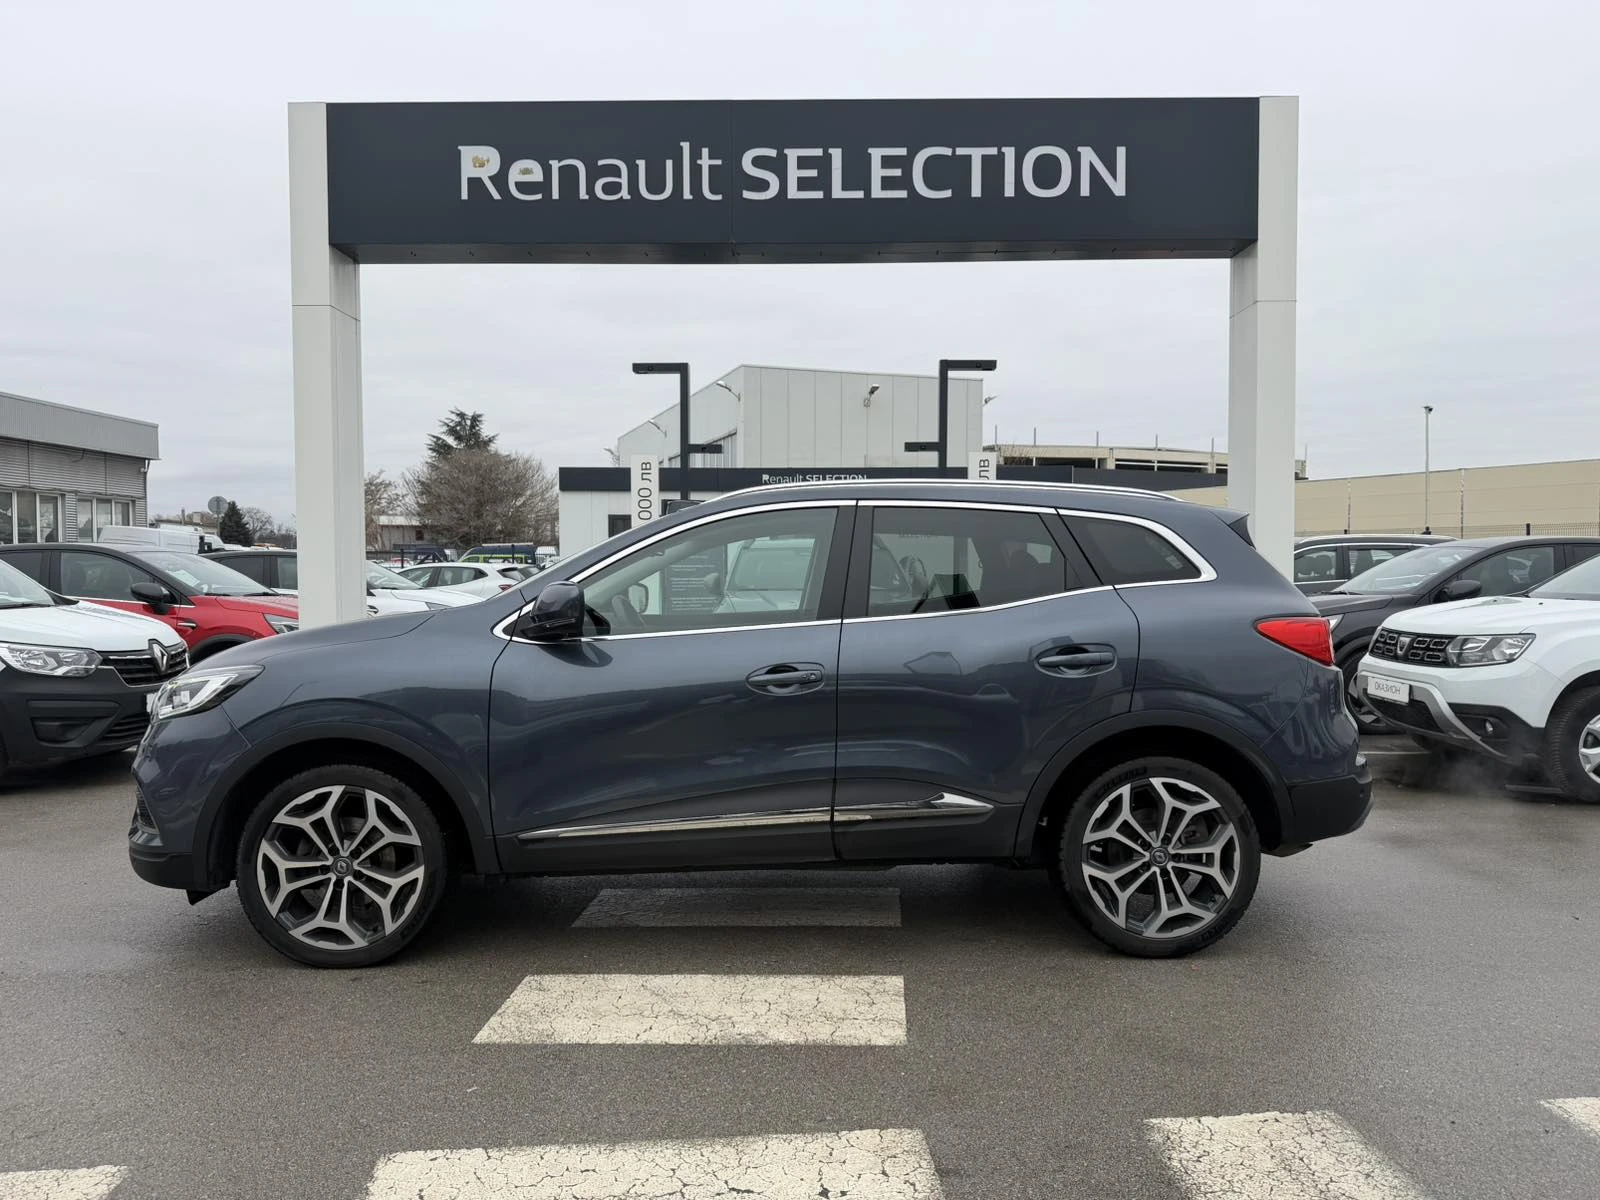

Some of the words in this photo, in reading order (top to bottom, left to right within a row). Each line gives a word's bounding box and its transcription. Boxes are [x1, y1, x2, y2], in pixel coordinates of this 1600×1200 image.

[458, 142, 722, 200] Renault
[741, 145, 1126, 200] SELECTION
[762, 473, 804, 484] Renault
